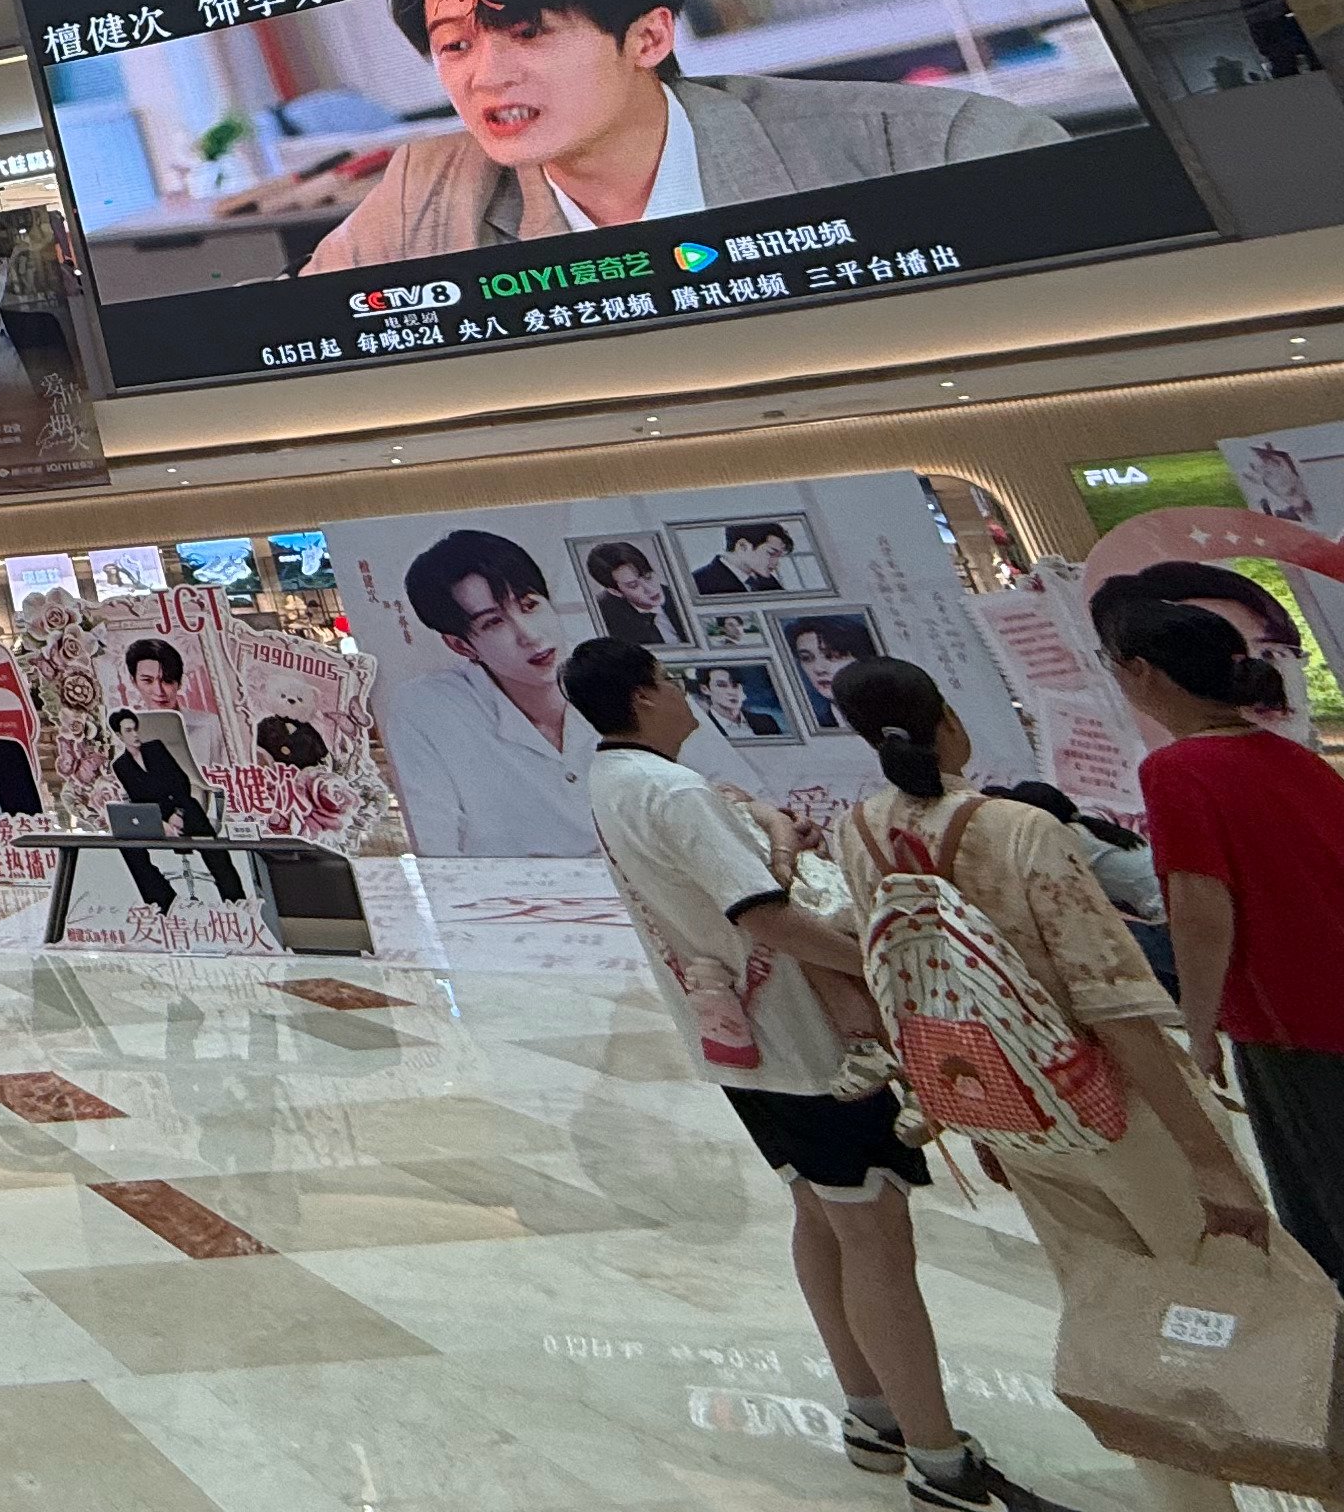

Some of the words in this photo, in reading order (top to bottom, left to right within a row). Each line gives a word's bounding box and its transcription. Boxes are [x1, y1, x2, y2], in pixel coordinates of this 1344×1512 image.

[42, 5, 173, 64] 檀健次
[725, 219, 857, 263] 腾讯视频
[262, 337, 343, 367] 6.15日起
[356, 326, 444, 355] 每晚9:24
[458, 316, 509, 342] 央八
[524, 292, 659, 333] 爱奇艺视频
[670, 272, 790, 311] 腾讯视频
[805, 245, 961, 289] 三平台播出
[1082, 465, 1150, 488] FILA
[154, 586, 224, 635] JCT
[252, 643, 340, 682] 19901005
[127, 905, 274, 952] 爱情有烟火
